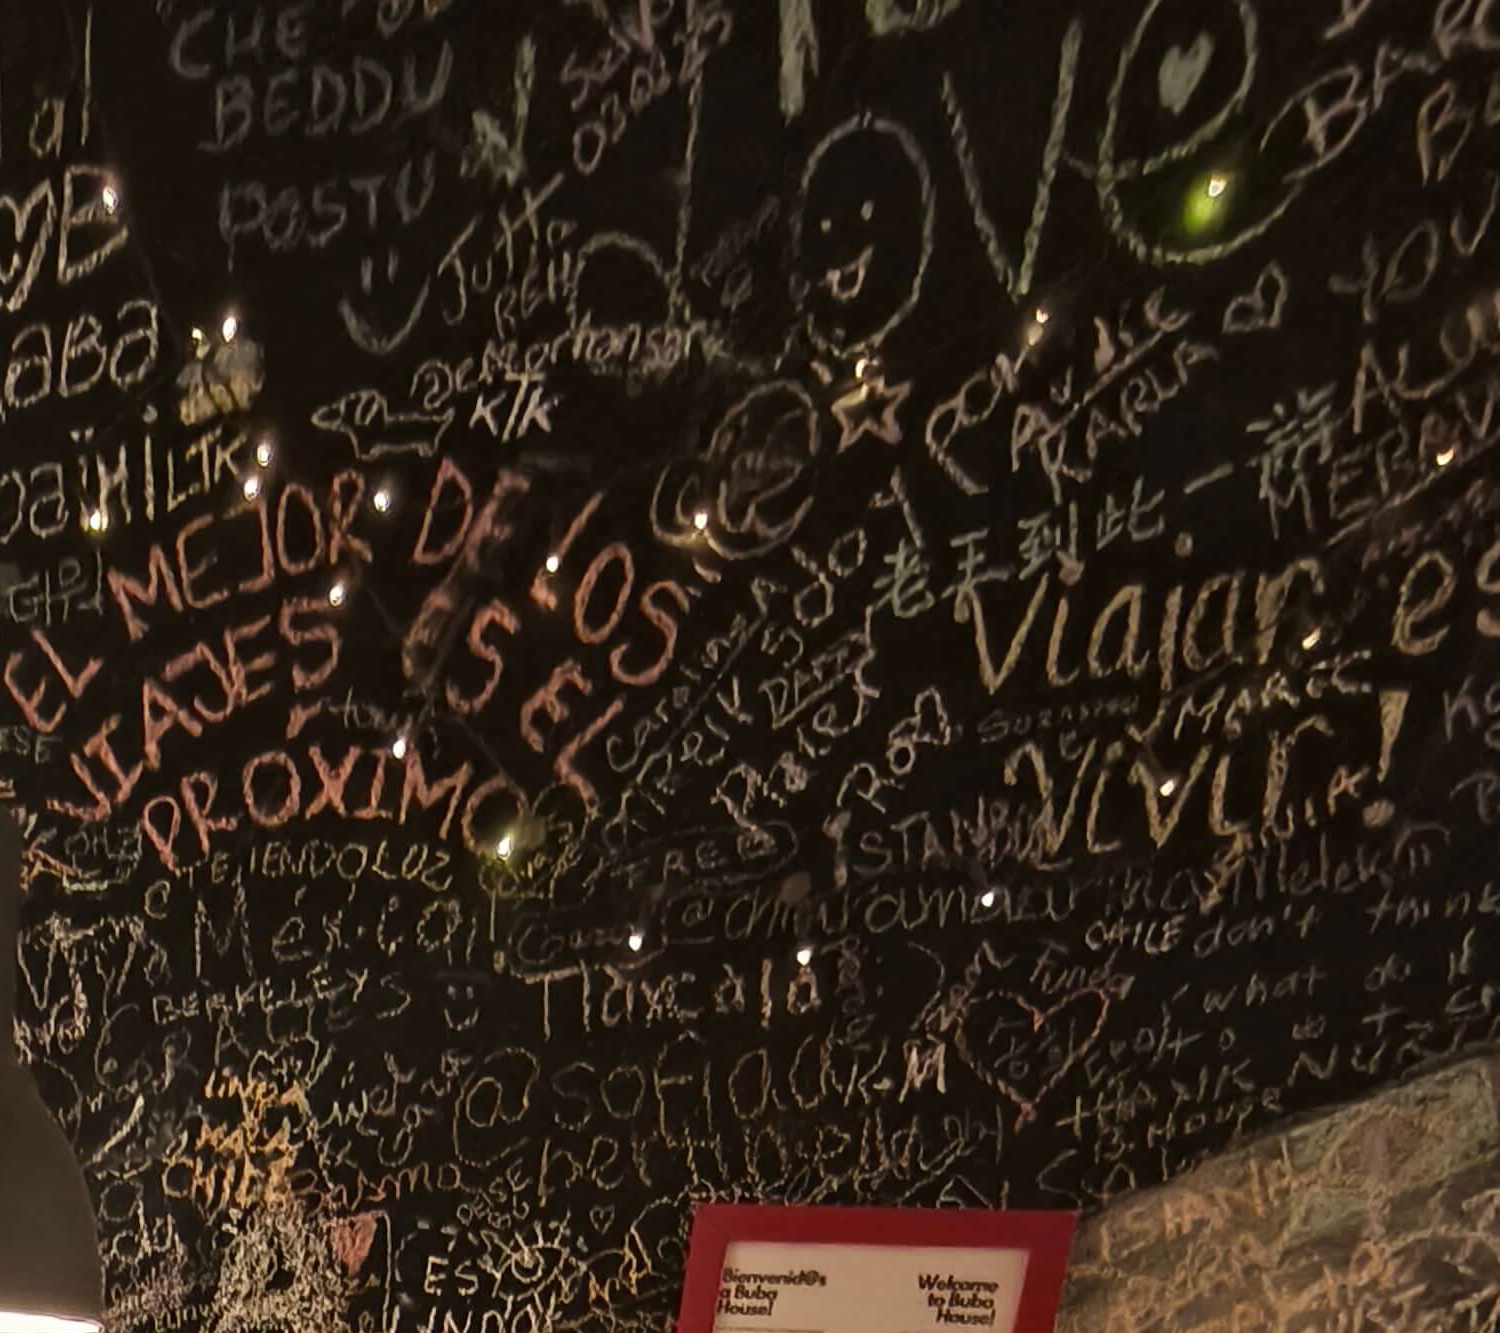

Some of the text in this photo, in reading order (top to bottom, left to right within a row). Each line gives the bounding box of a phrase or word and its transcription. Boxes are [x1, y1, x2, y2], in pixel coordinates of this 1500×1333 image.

[2, 625, 102, 733] EL
[107, 469, 373, 641] MEJOR
[411, 455, 531, 575] DE
[530, 492, 692, 686] LOS
[953, 556, 1327, 696] Viajar
[47, 598, 340, 822] VIAJES
[717, 1300, 774, 1317] House!
[918, 1274, 1000, 1293] Welcome
[936, 1307, 997, 1327] House!
